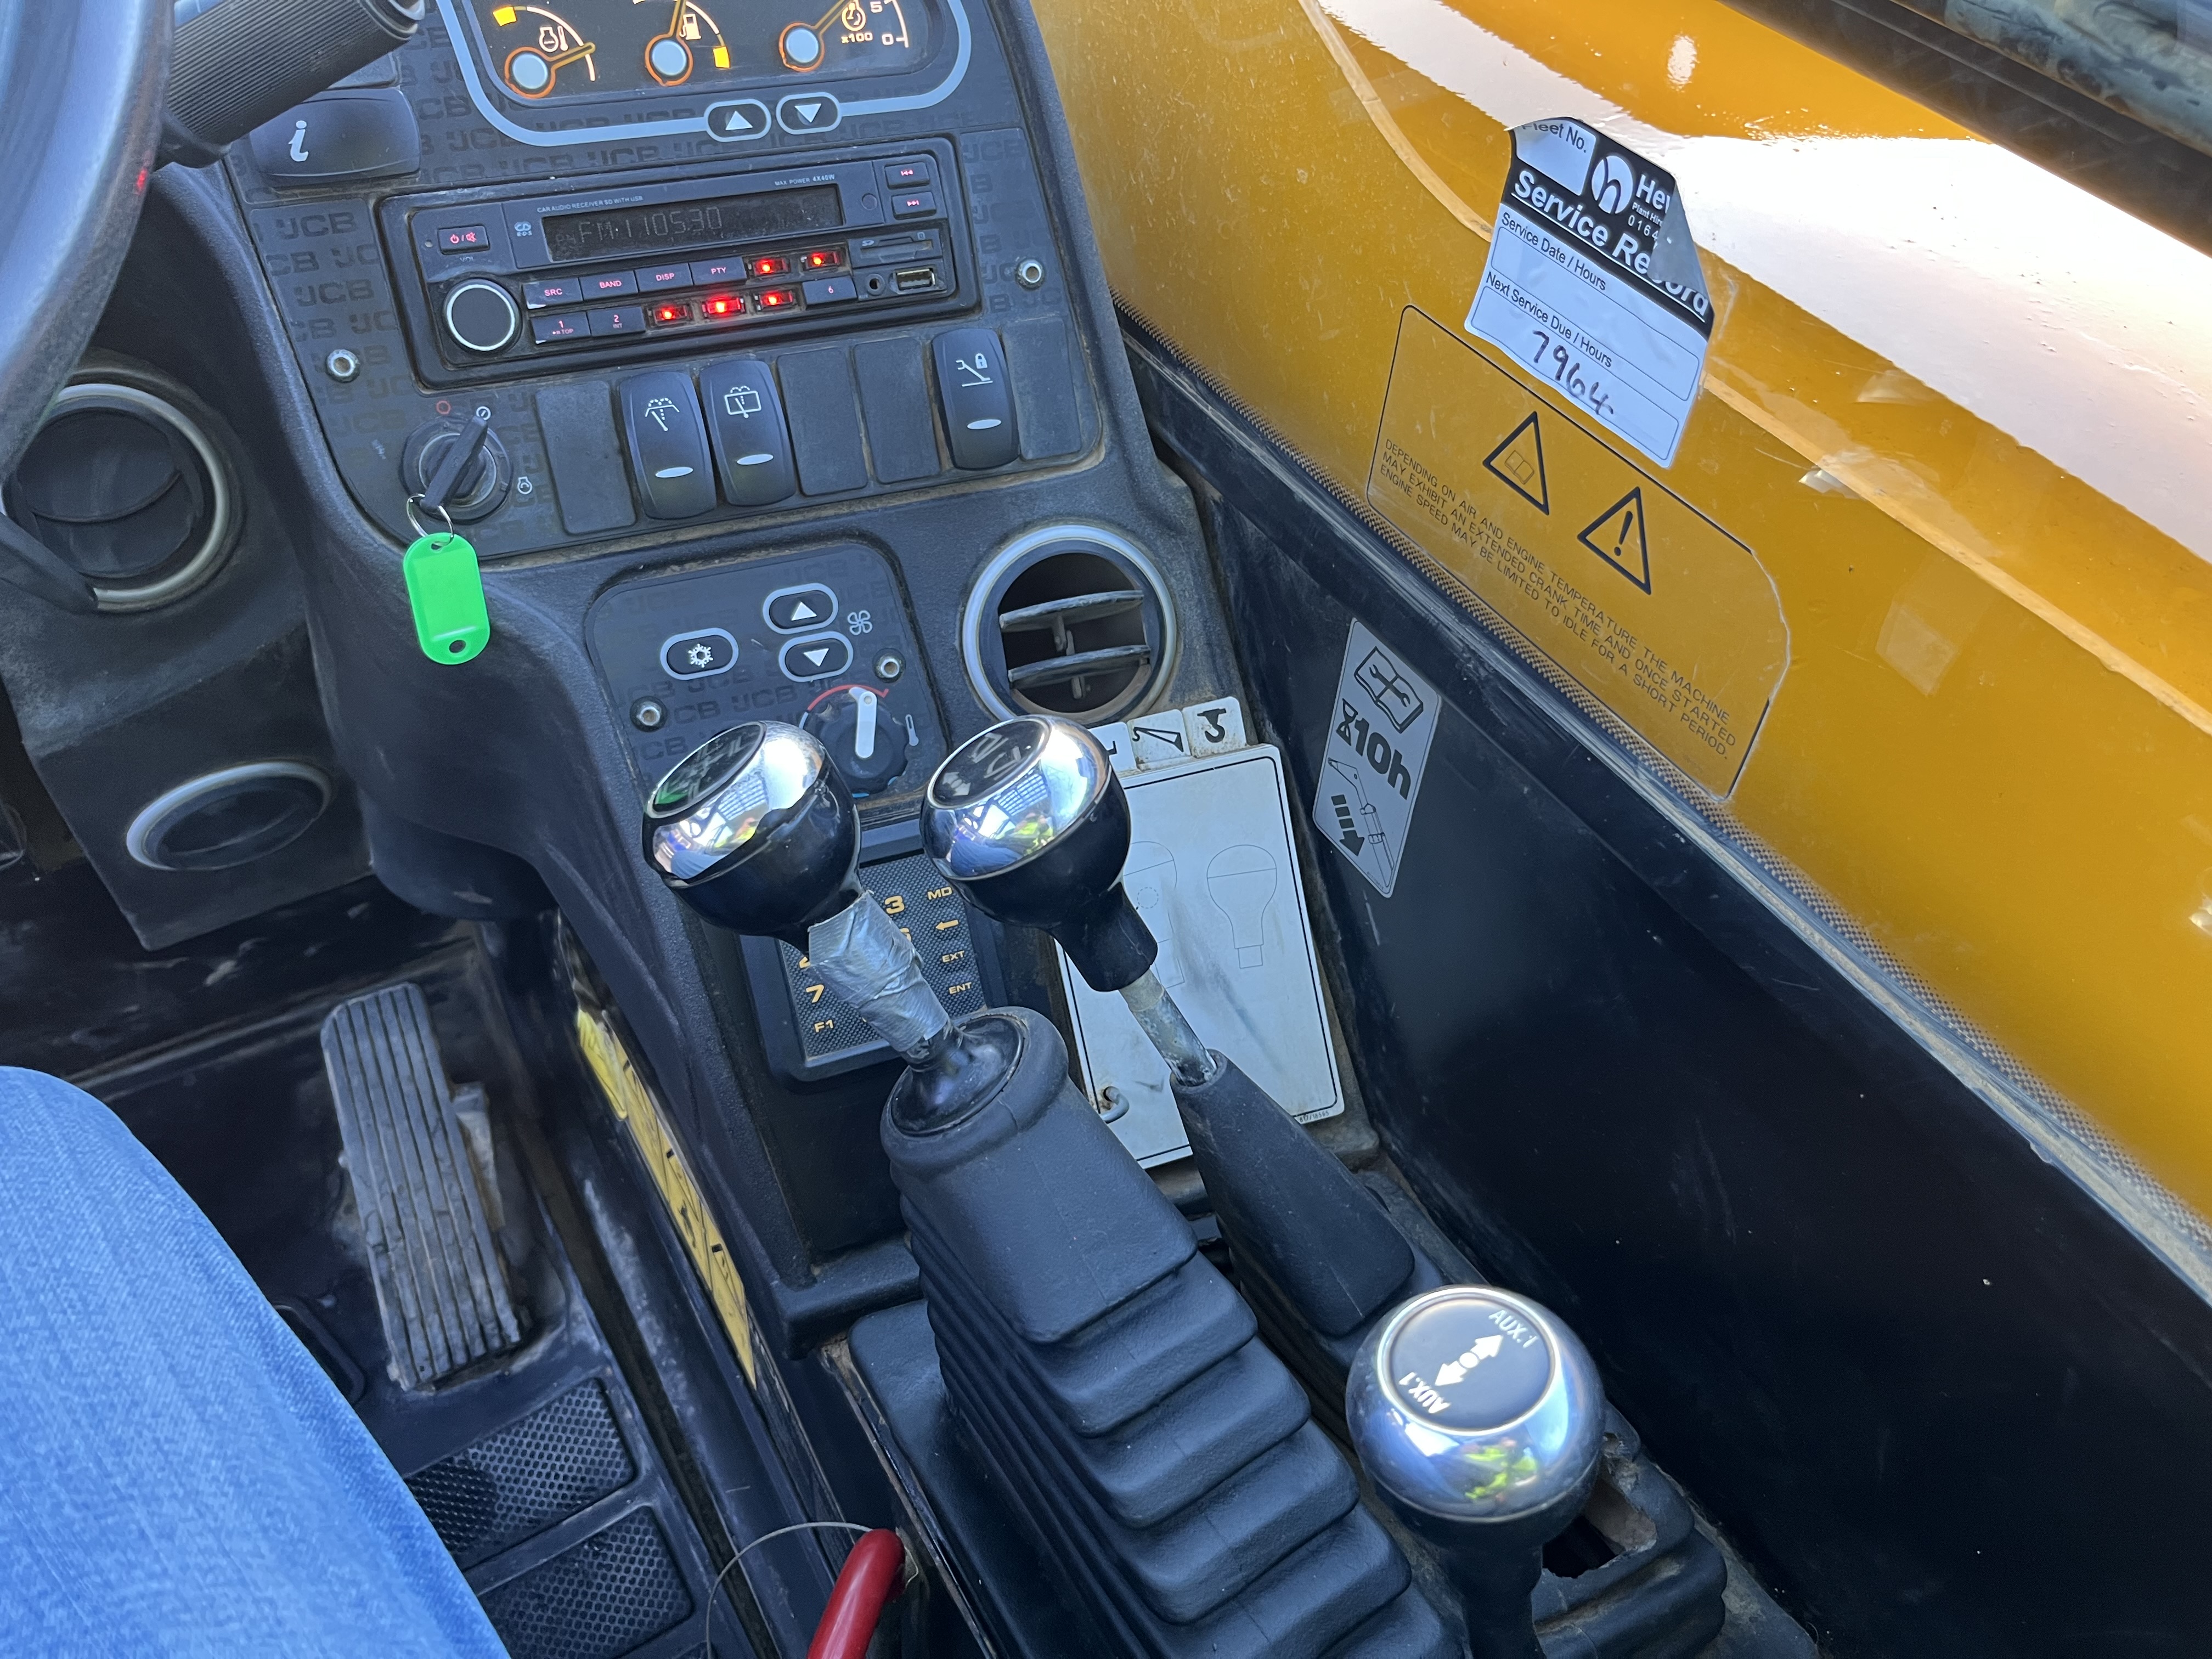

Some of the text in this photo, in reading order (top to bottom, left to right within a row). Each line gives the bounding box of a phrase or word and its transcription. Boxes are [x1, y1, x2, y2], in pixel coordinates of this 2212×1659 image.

[841, 32, 873, 43] x100
[882, 33, 894, 46] 0
[1566, 126, 1586, 153] No.
[572, 200, 603, 209] RECEIVER
[1514, 170, 1609, 247] Service
[1632, 202, 1650, 218] Plant
[275, 212, 356, 239] JCB
[330, 244, 380, 268] JC
[1502, 212, 1606, 291] Service Date / Hours
[266, 251, 320, 276] CB
[599, 280, 622, 289] BAND
[655, 273, 675, 281] DISP
[295, 279, 374, 306] JCB
[544, 288, 563, 296] SRC
[827, 285, 834, 294] 6
[290, 318, 337, 341] CB
[349, 311, 398, 334] JC
[558, 320, 564, 328] 1
[613, 314, 619, 323] 2
[1486, 271, 1612, 368] Next Service Due / Hours
[1533, 330, 1614, 415] 7964
[1386, 439, 1730, 725] DEPENDING ON AIR AND ENGINE TEMPERATURE THE MACHINE
[1383, 452, 1736, 746] MAY EXHIBIT AN EXTENDED CRANK TIME AND ONCE STARTED
[1380, 464, 1728, 760] ENGINE SPEED MAY BE LIMITED TO IDLE FOR A SHORT PERIOD.
[675, 701, 721, 724] CB
[633, 736, 689, 760] CB
[1354, 717, 1412, 800] 10h
[927, 886, 953, 900] MD
[884, 895, 905, 915] 3
[941, 950, 965, 963] EXT
[805, 984, 825, 1003] 7
[949, 982, 972, 995] ENT
[814, 1019, 834, 1033] F1
[1488, 1309, 1540, 1349] AUX.1
[1398, 1371, 1452, 1414] AUX.1
